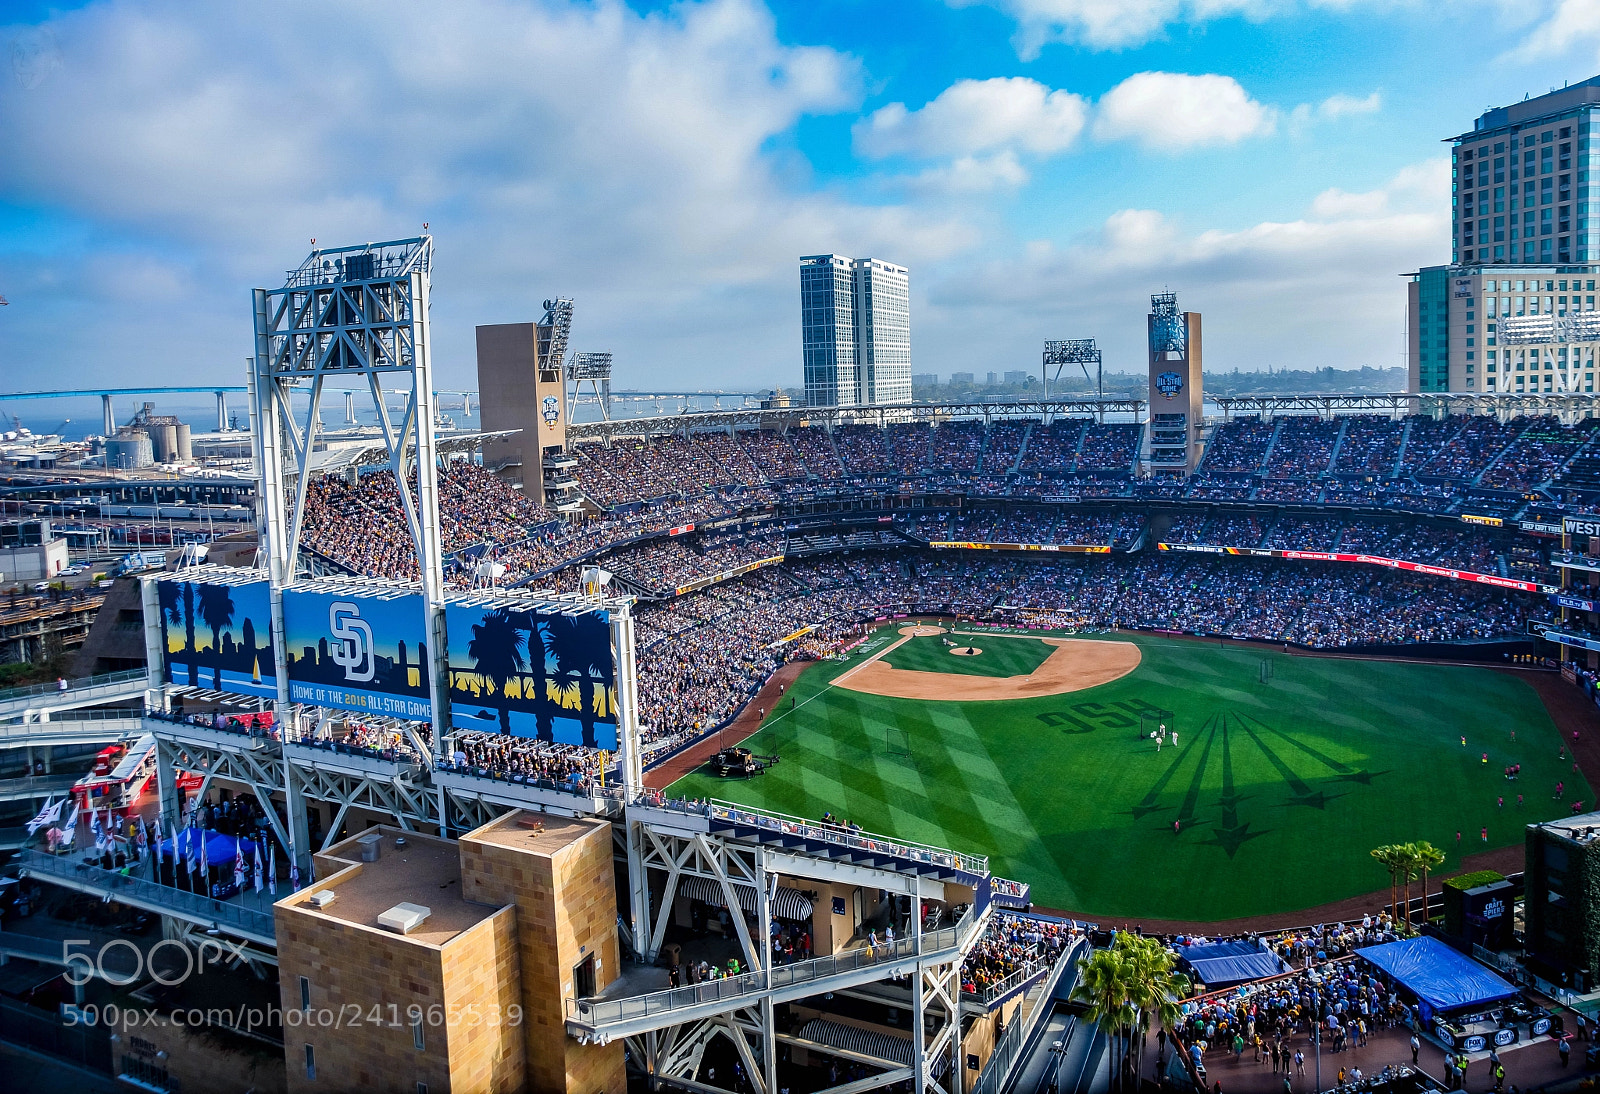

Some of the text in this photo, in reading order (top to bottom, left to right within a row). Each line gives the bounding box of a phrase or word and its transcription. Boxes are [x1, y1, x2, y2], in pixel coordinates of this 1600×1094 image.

[330, 601, 375, 682] SD
[292, 685, 314, 700] HOME
[316, 686, 325, 701] OF
[328, 688, 343, 704] THE
[345, 694, 366, 707] 2016
[408, 701, 431, 717] GAME
[1485, 900, 1502, 910] CRAFT
[1488, 907, 1501, 916] PIER
[1499, 1032, 1509, 1042] FOX
[1468, 1039, 1481, 1047] FOX
